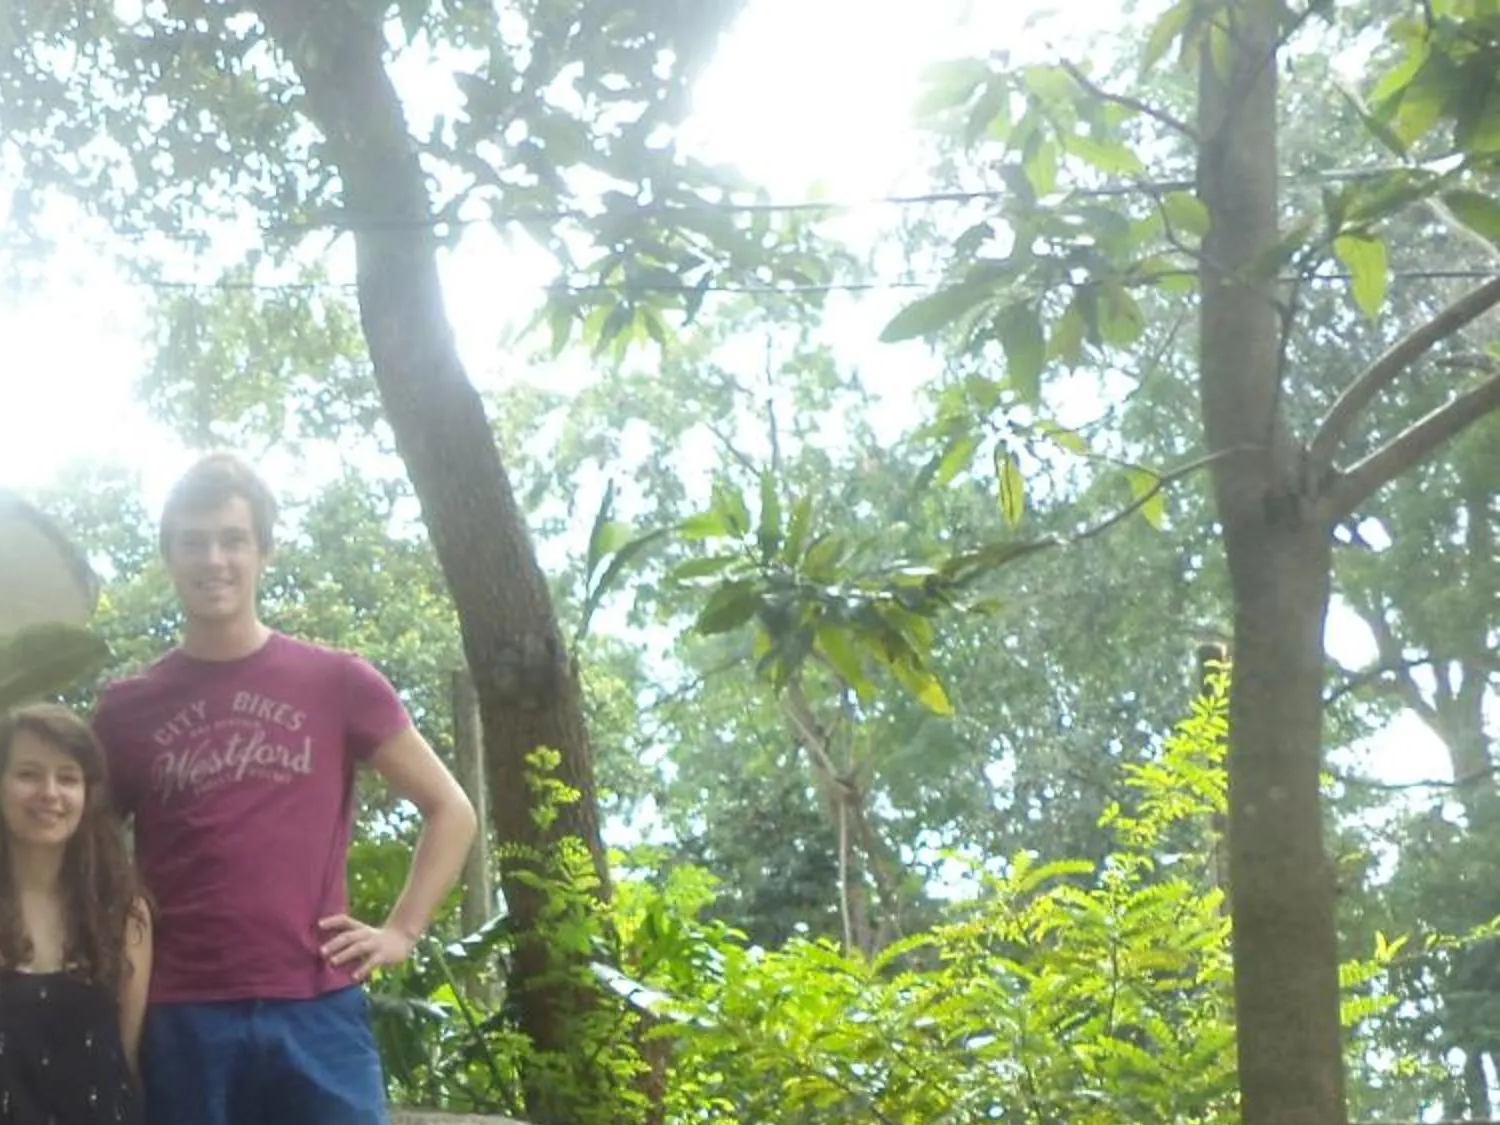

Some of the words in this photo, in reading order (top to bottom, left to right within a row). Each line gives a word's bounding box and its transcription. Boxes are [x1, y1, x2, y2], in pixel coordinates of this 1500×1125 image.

[152, 699, 206, 746] CITY
[232, 690, 307, 731] BIKES
[151, 730, 313, 803] Westford
